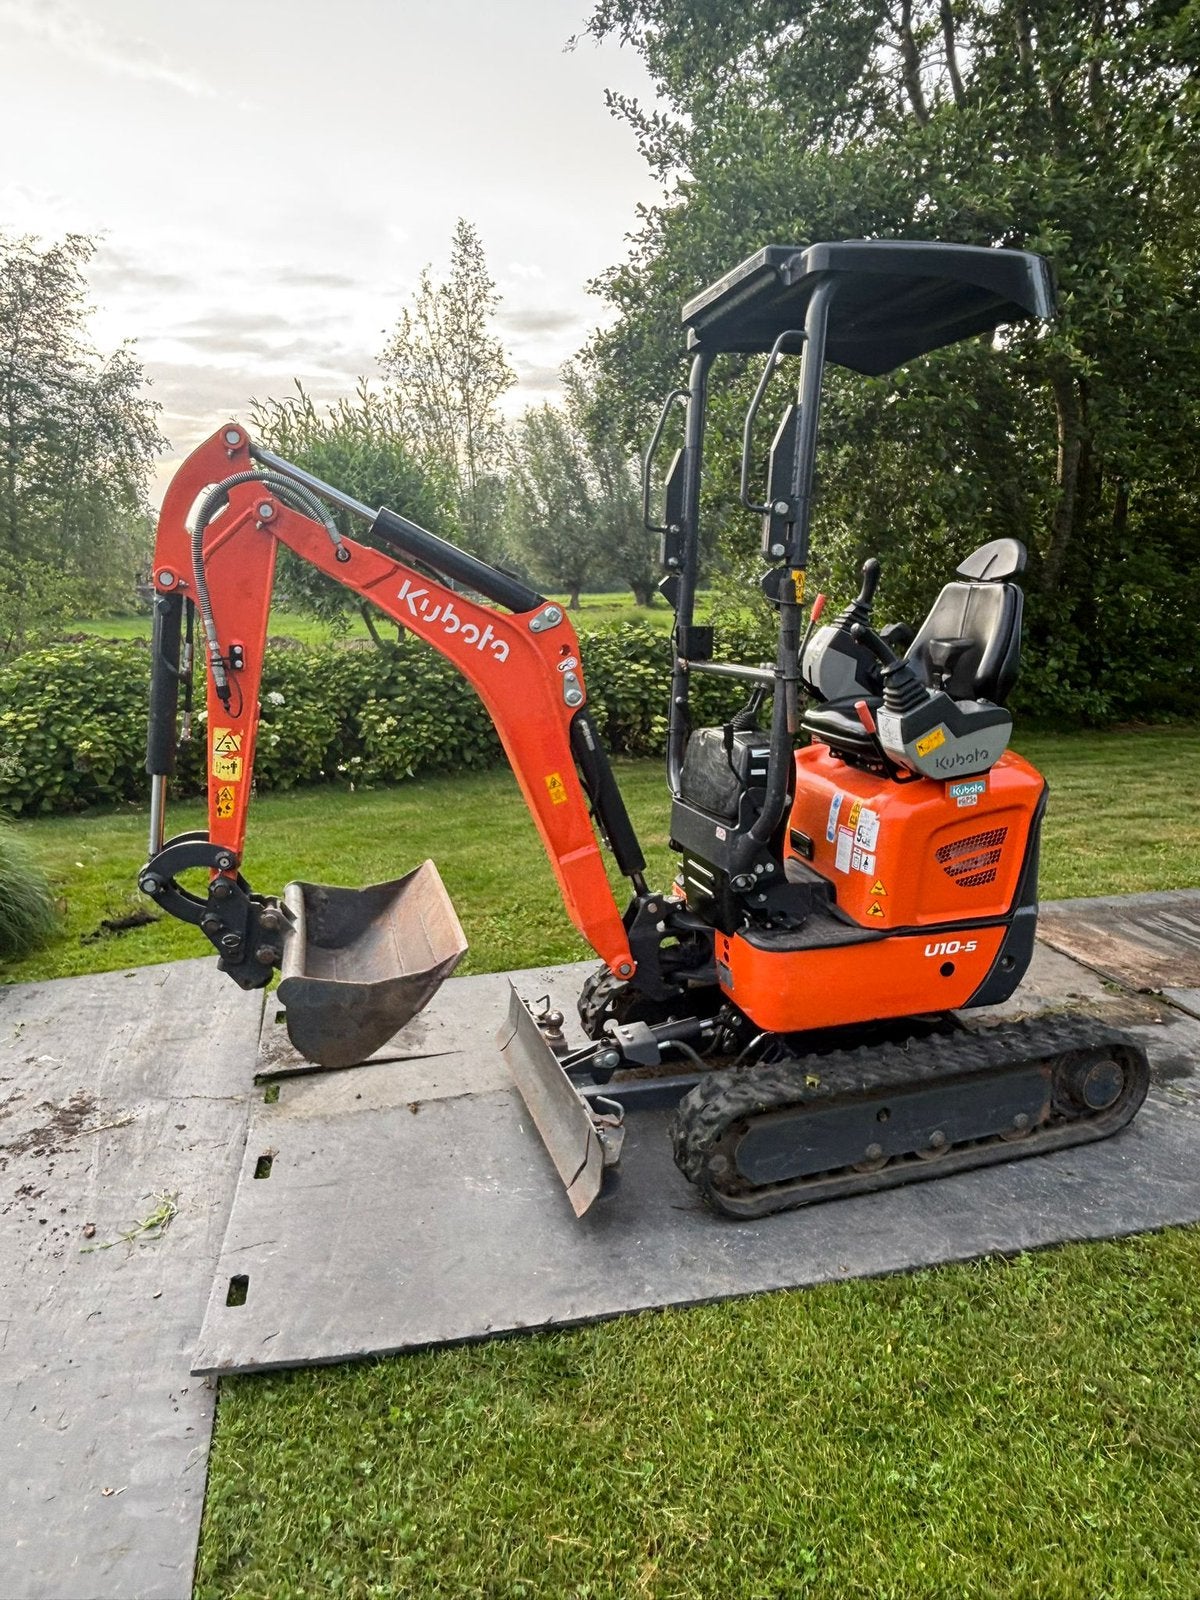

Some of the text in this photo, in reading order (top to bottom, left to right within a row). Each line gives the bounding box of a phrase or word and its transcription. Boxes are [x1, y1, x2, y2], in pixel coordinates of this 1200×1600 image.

[397, 579, 510, 663] Kubota
[936, 748, 989, 770] Kubota
[952, 783, 983, 796] Kubota
